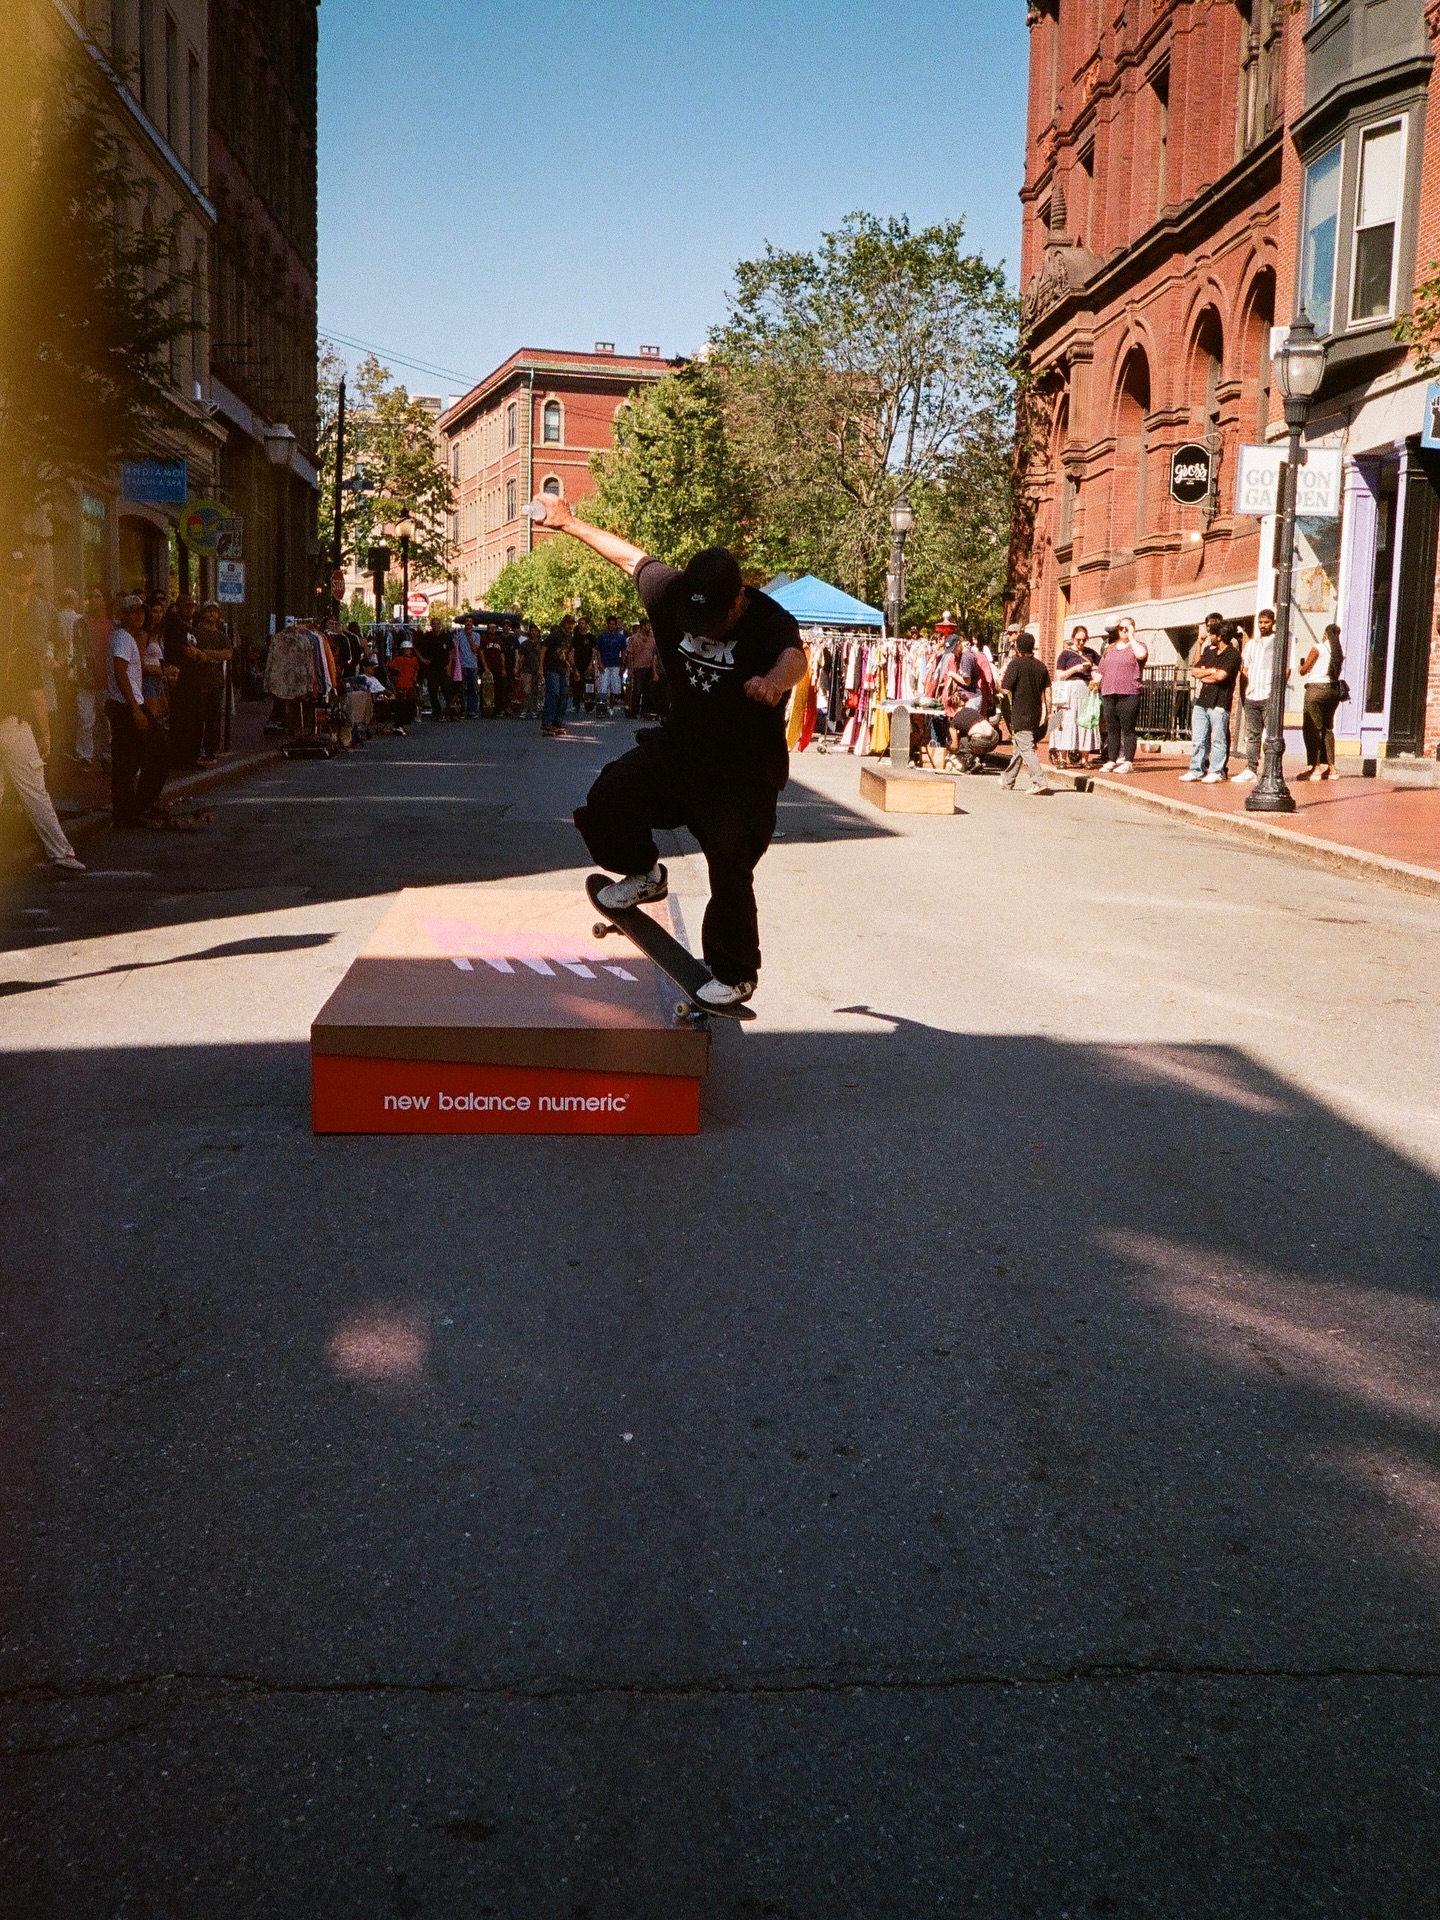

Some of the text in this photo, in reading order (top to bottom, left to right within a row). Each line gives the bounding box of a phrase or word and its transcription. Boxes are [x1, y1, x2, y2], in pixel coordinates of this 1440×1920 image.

[1174, 463, 1208, 484] gross
[1246, 488, 1330, 508] GADEN
[384, 1095, 430, 1110] new
[438, 1092, 530, 1111] balance
